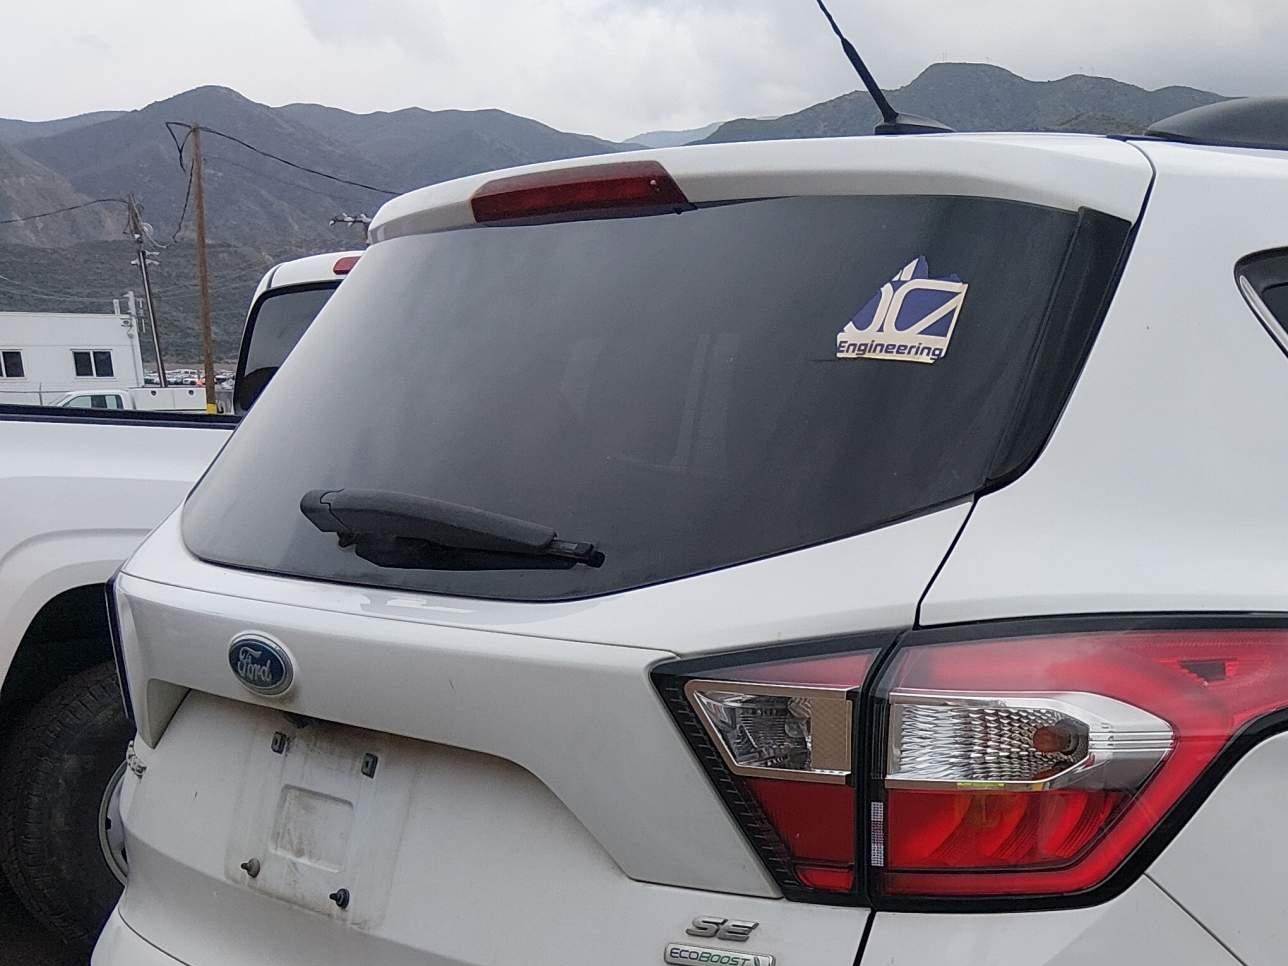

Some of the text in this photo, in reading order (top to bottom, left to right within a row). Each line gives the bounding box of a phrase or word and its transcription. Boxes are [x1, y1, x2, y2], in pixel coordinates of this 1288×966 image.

[838, 340, 944, 360] Engineering
[237, 647, 273, 681] Ford
[685, 915, 760, 942] SE
[669, 947, 751, 966] ECOBOOST
